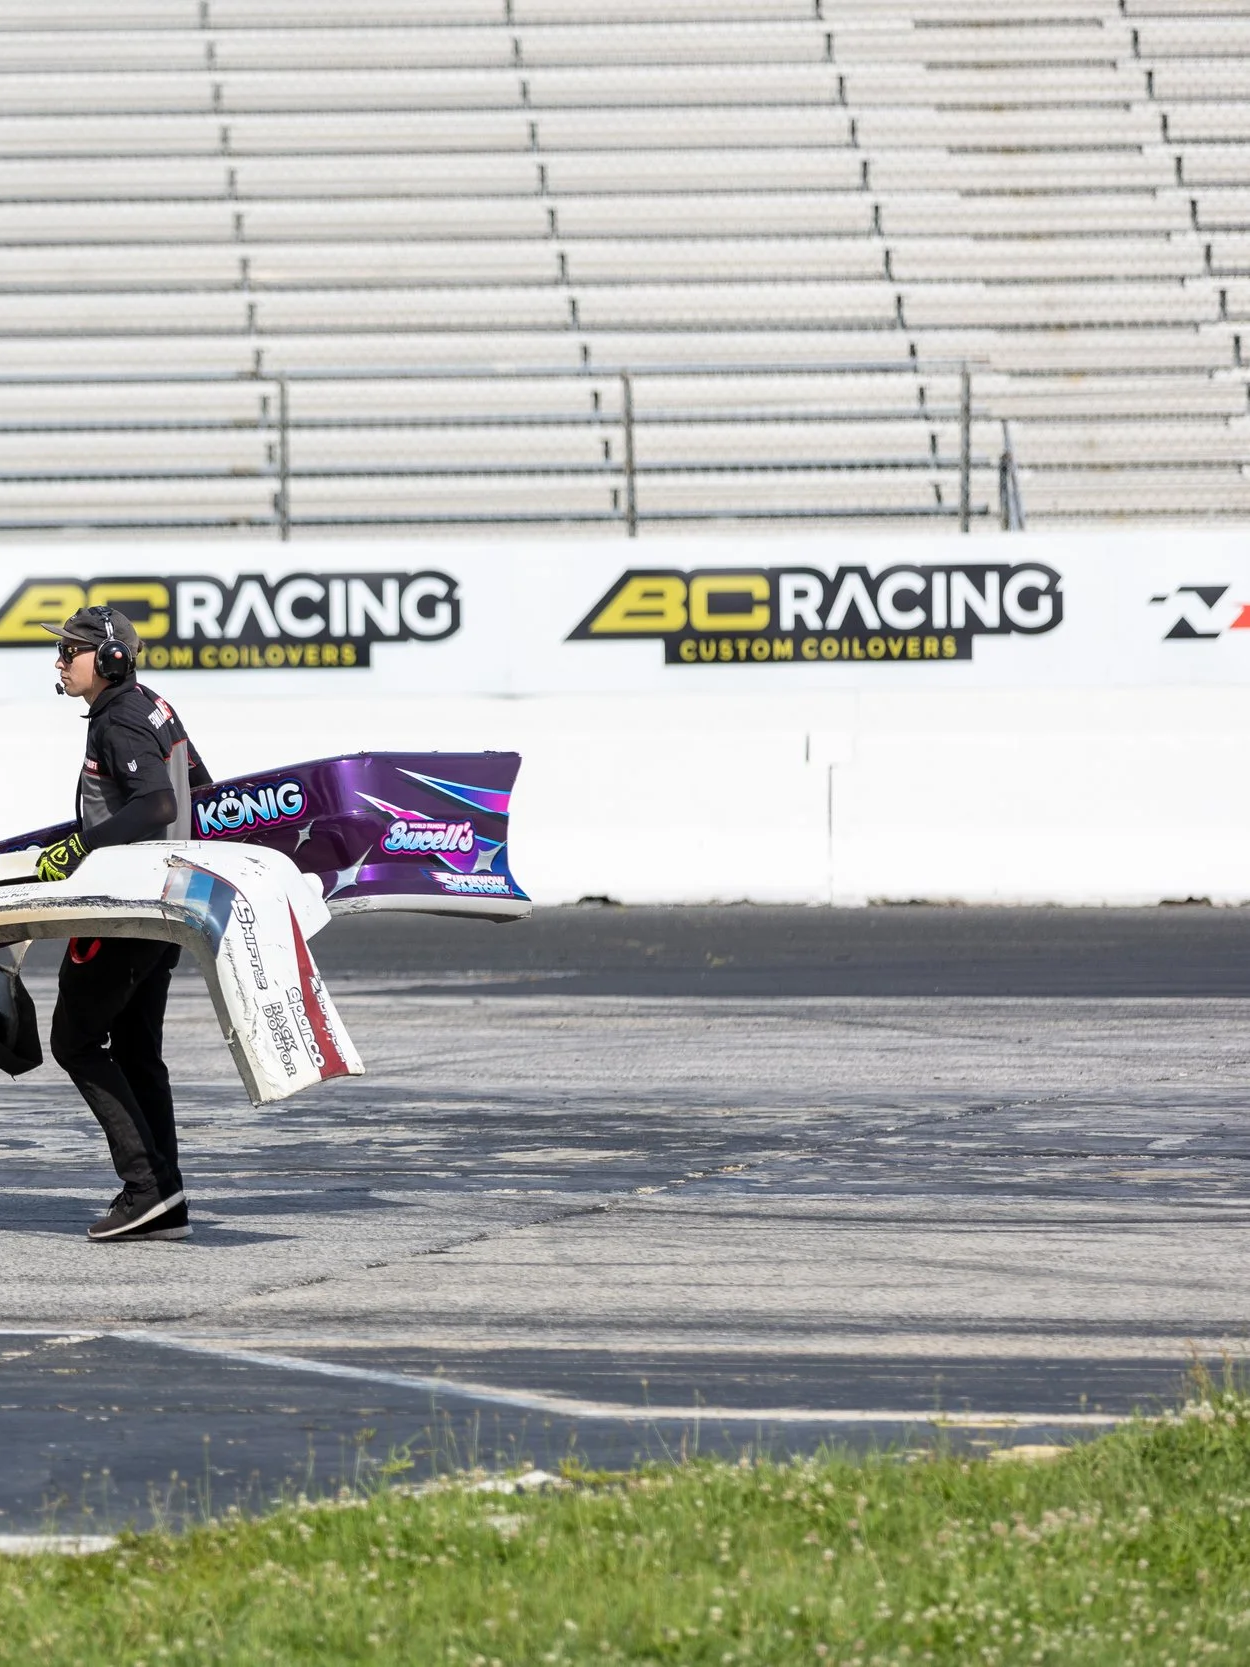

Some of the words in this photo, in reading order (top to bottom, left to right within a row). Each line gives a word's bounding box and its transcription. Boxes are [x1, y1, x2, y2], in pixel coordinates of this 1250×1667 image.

[176, 574, 453, 639] RACING
[588, 573, 771, 634] BC
[777, 569, 1054, 633] RACING
[136, 644, 194, 669] TOM
[199, 642, 358, 669] COILOVERS
[678, 637, 794, 662] CUSTOM
[800, 635, 958, 660] COILOVERS
[196, 782, 304, 835] KÖNIG
[408, 822, 426, 830] WORLD
[384, 820, 474, 852] Bucell's
[262, 1004, 297, 1078] DOCTOR
[273, 1001, 300, 1053] RACK
